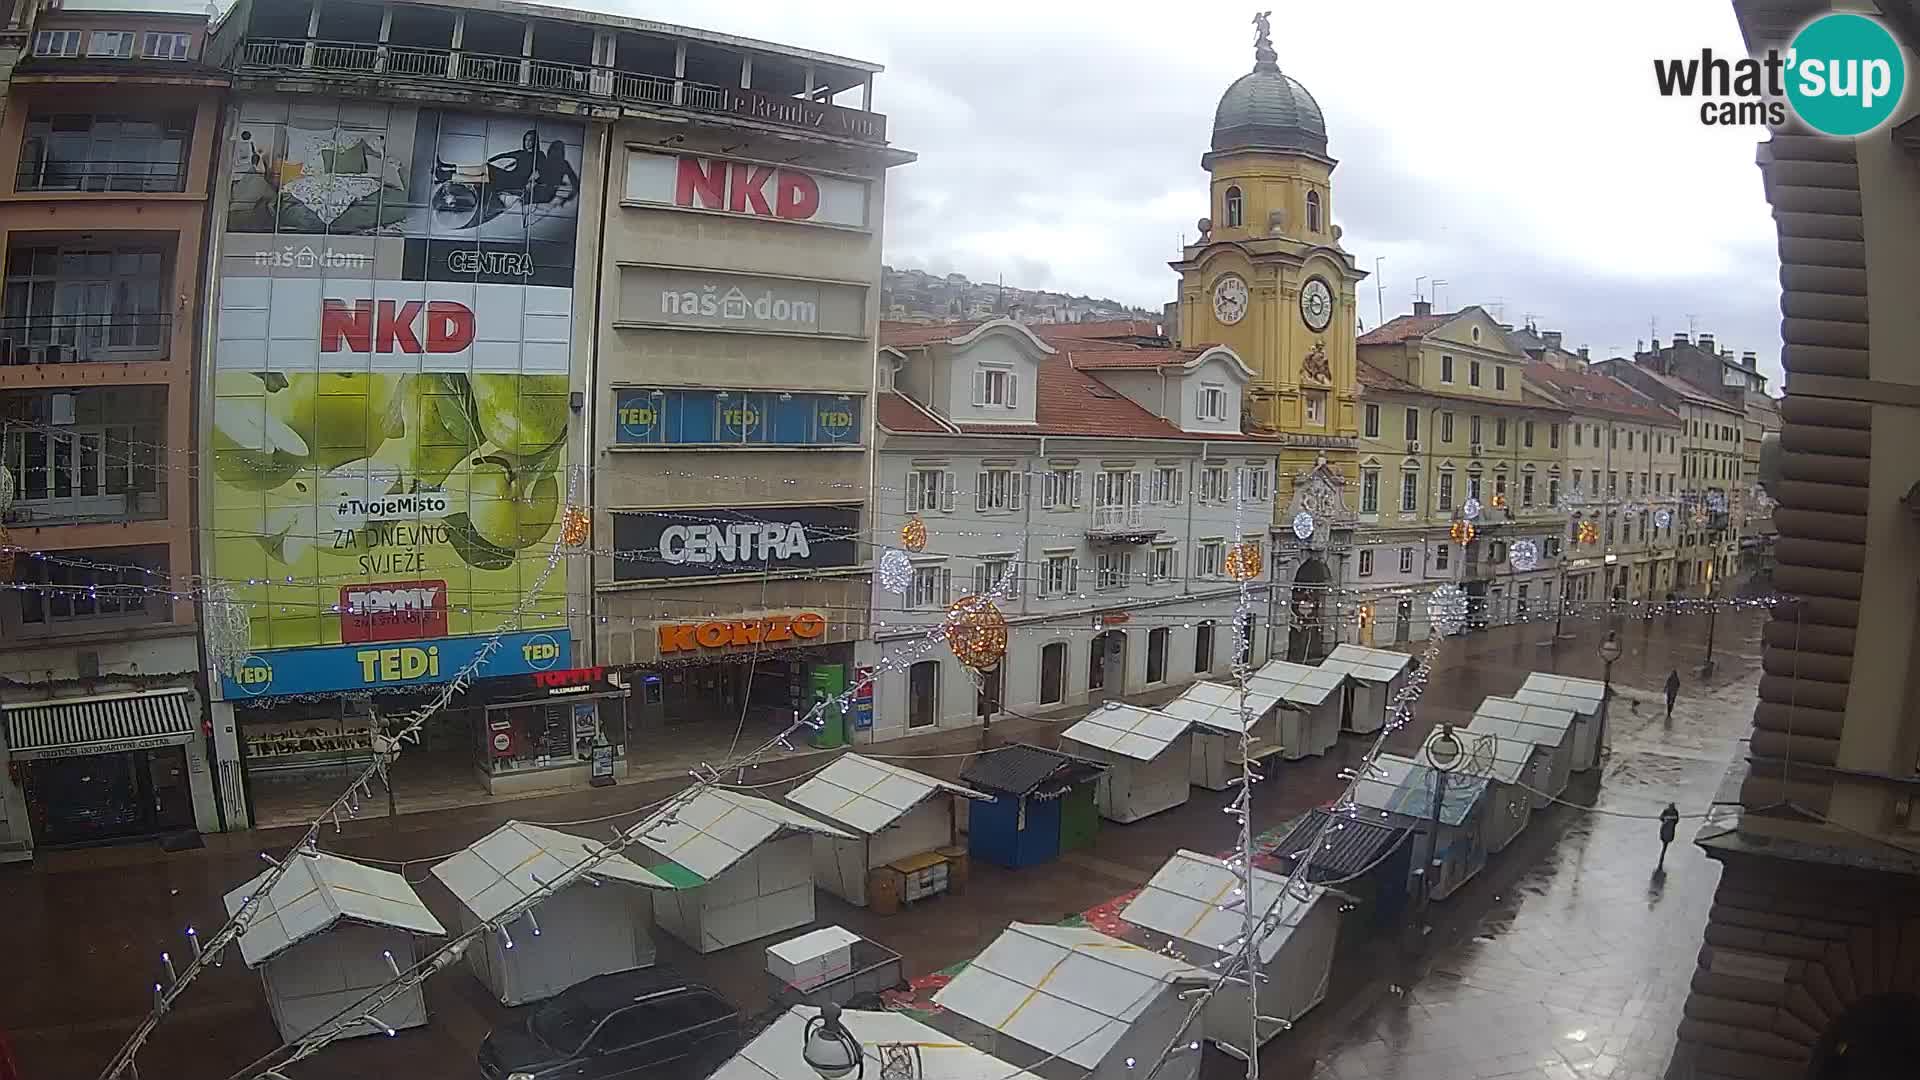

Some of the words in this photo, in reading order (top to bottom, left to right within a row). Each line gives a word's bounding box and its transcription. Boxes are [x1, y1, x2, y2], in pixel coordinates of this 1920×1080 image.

[752, 95, 824, 126] Rendez
[676, 158, 821, 220] NKD
[255, 246, 293, 268] naš
[319, 248, 365, 269] dom
[448, 250, 534, 276] CENTRA
[661, 284, 718, 316] naš
[754, 290, 816, 322] dom
[320, 299, 476, 353] NKD
[619, 409, 657, 425] TEDi
[724, 410, 759, 425] TEDi
[820, 411, 853, 427] TEDi
[338, 497, 446, 516] #TvojeMisto
[334, 529, 357, 549] ZA
[368, 524, 450, 547] DNEVNO
[659, 521, 810, 564] CENTRA
[359, 548, 425, 575] SVJEŽE
[348, 587, 438, 614] TOMMY
[659, 612, 825, 653] KORZO
[357, 646, 440, 683] TEDi
[522, 642, 560, 661] TEDi
